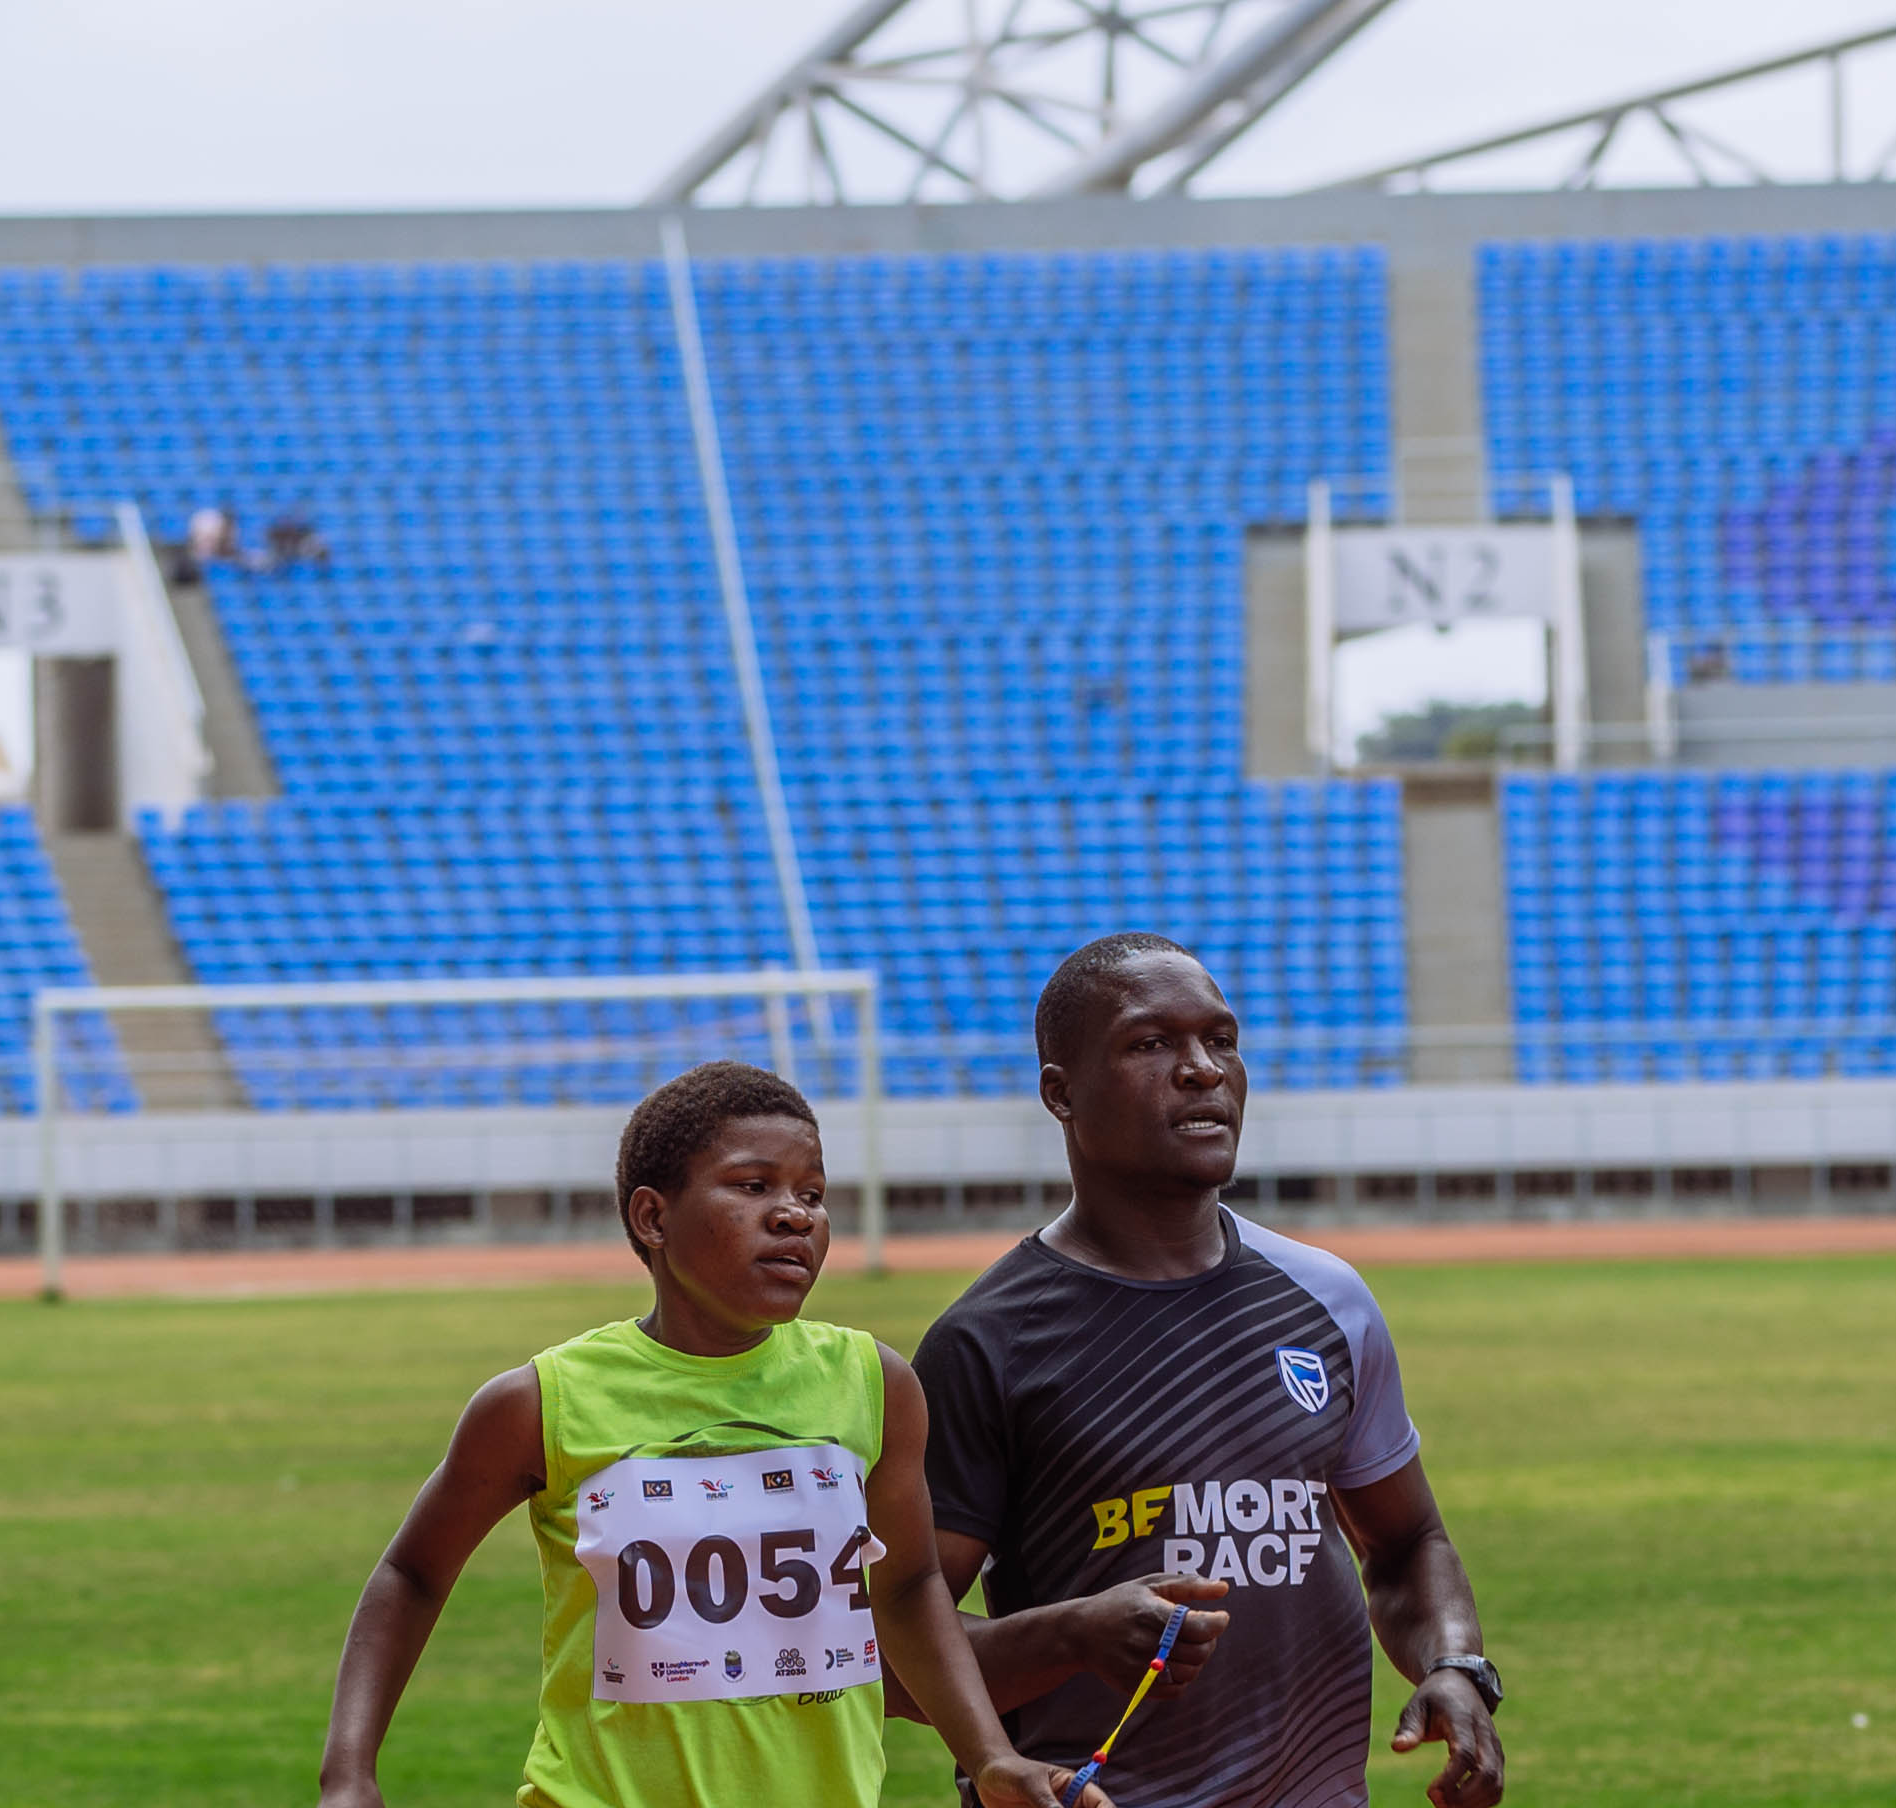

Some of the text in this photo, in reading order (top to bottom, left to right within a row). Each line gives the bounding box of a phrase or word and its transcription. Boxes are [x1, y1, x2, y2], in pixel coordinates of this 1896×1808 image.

[1387, 542, 1501, 613] N2
[617, 1525, 872, 1630] 0054
[1163, 1533, 1321, 1587] RACE
[666, 1668, 697, 1676] University
[775, 1668, 807, 1677] AT2030
